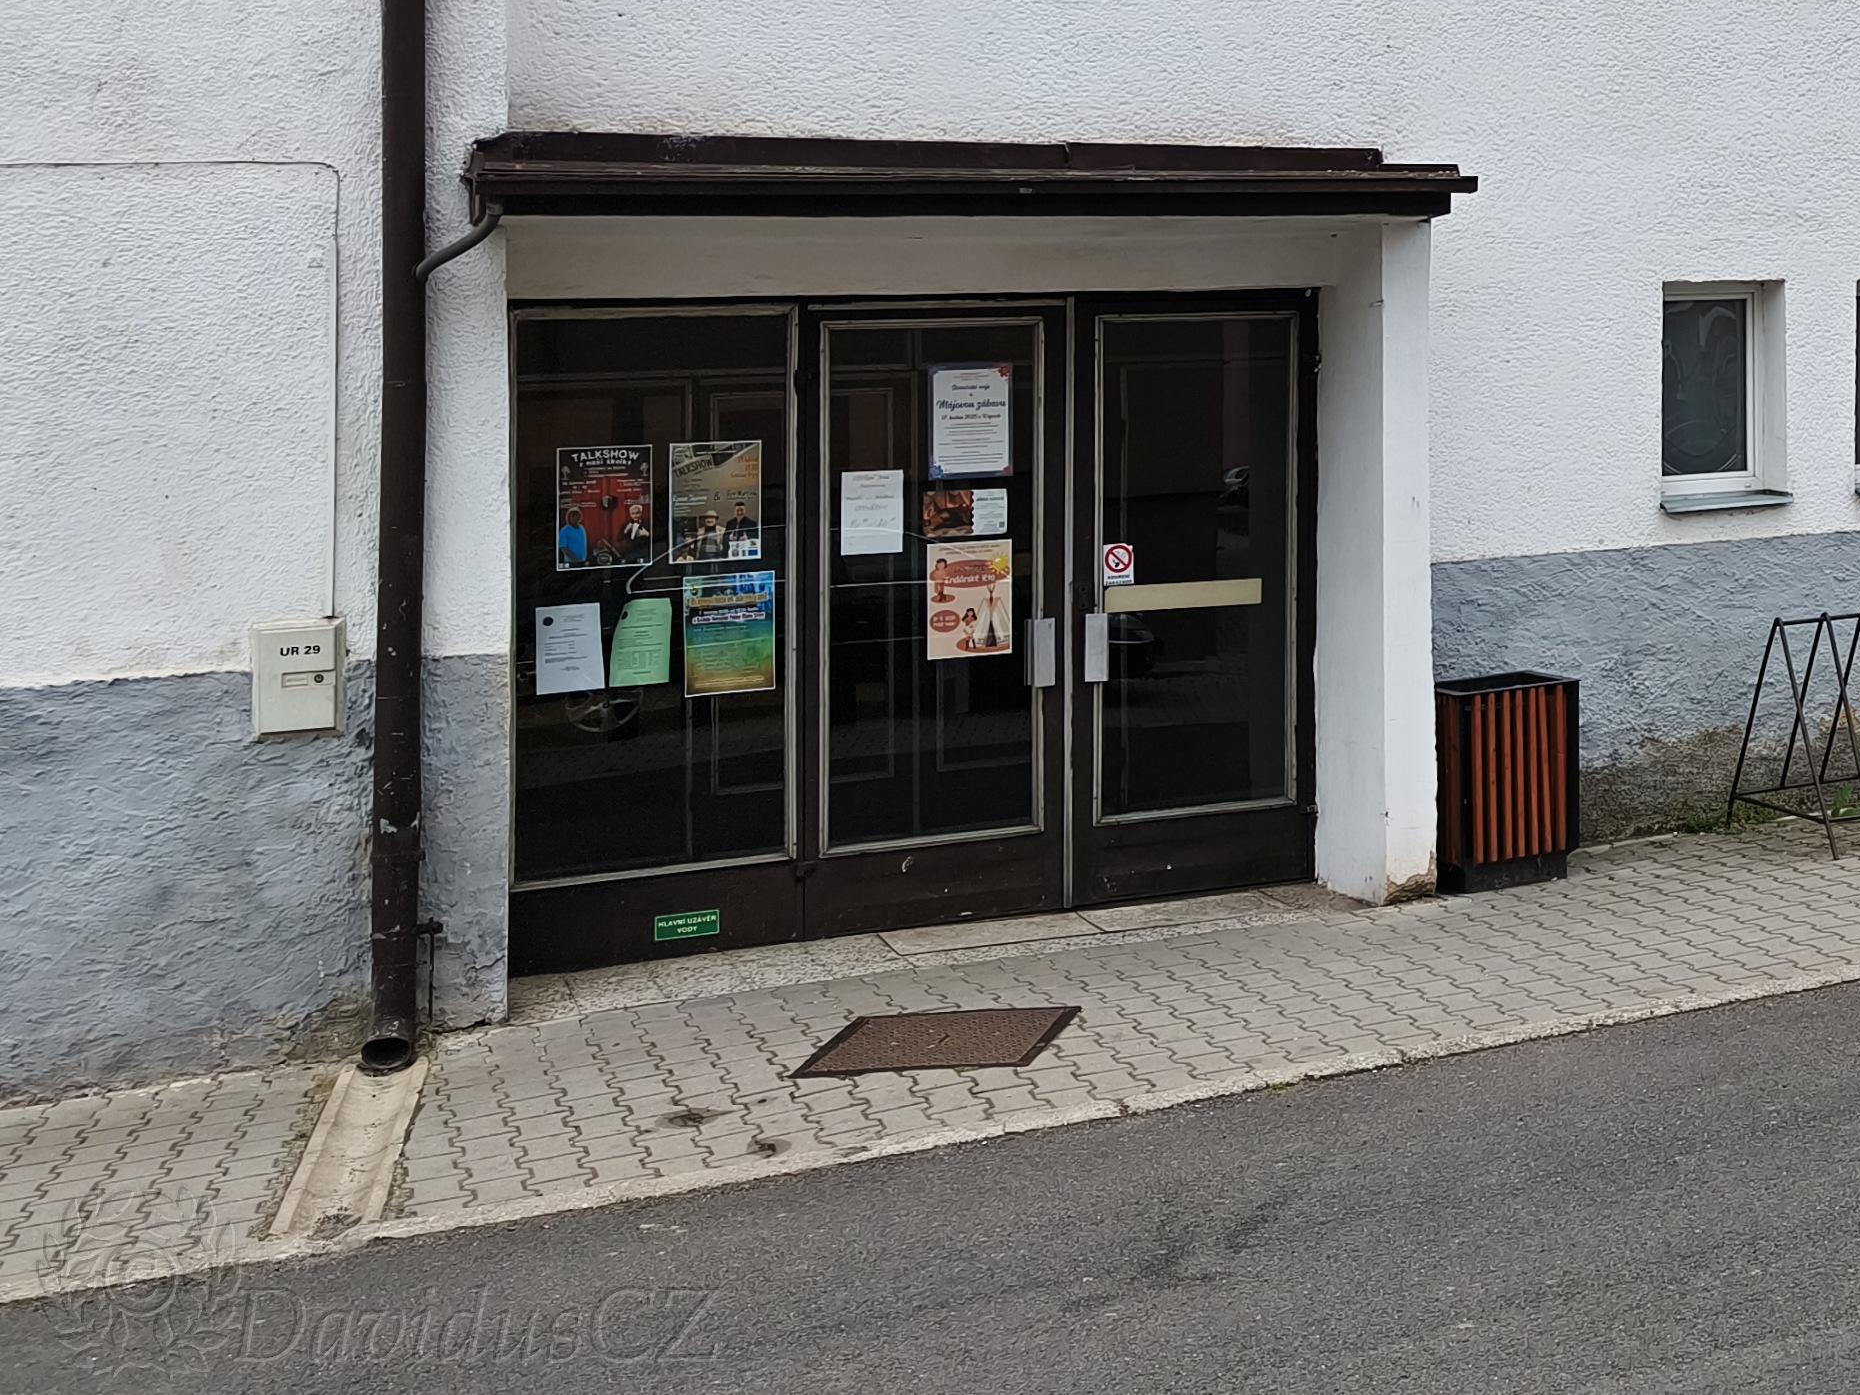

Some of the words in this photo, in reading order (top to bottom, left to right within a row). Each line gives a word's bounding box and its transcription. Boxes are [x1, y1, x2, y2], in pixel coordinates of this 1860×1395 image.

[571, 449, 640, 463] TALKSHOW
[280, 646, 300, 657] UR
[303, 645, 321, 655] 29
[658, 919, 686, 927] HLAVNÍ
